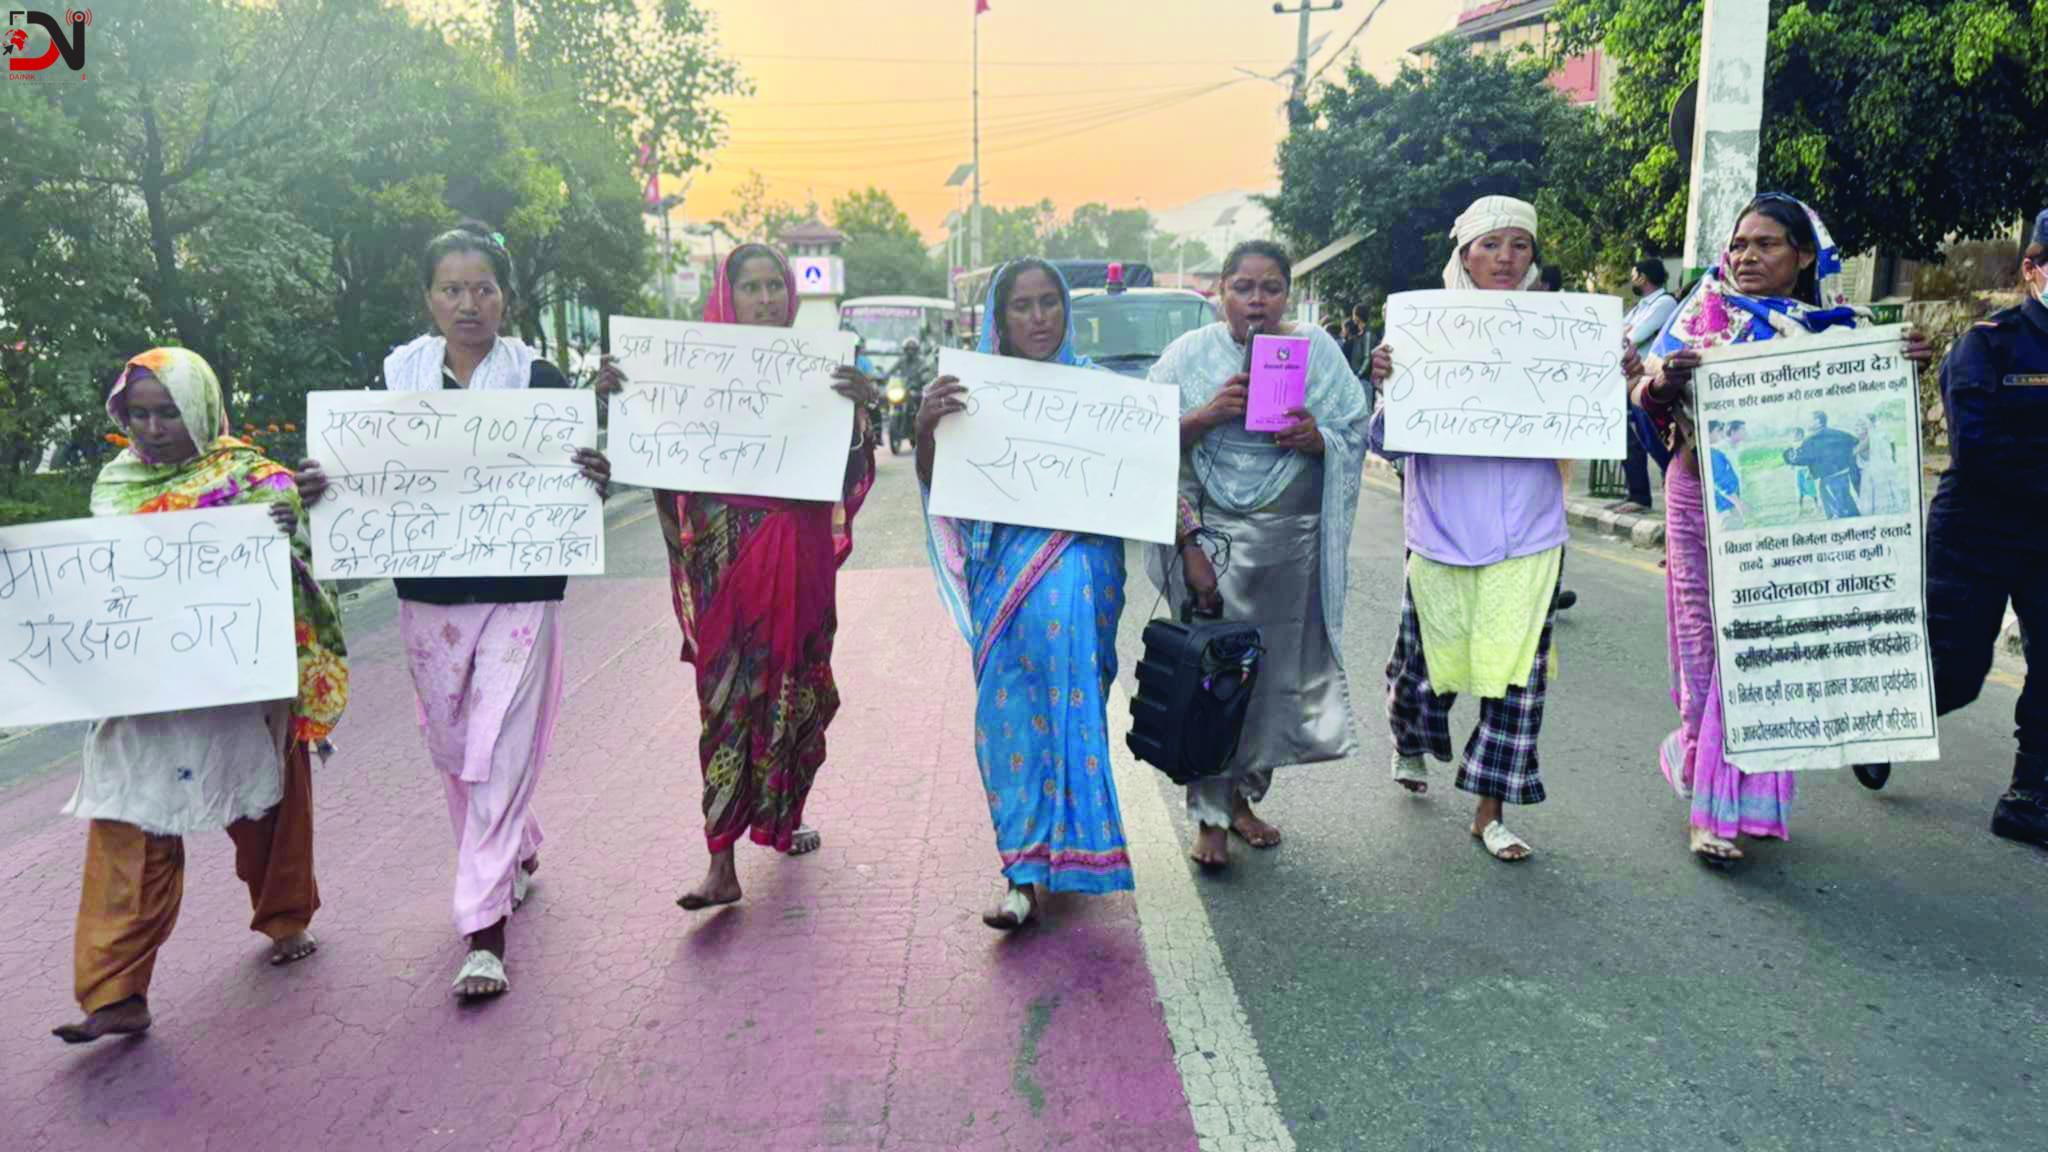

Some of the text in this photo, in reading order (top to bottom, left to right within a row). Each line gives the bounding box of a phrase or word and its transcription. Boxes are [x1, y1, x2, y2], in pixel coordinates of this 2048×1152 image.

[1707, 371, 1756, 391] निर्मला
[1826, 358, 1866, 376] न्याय
[1755, 536, 1789, 551] महिला
[0, 539, 121, 599] मानव
[1731, 579, 1830, 605] आन्दोलनका
